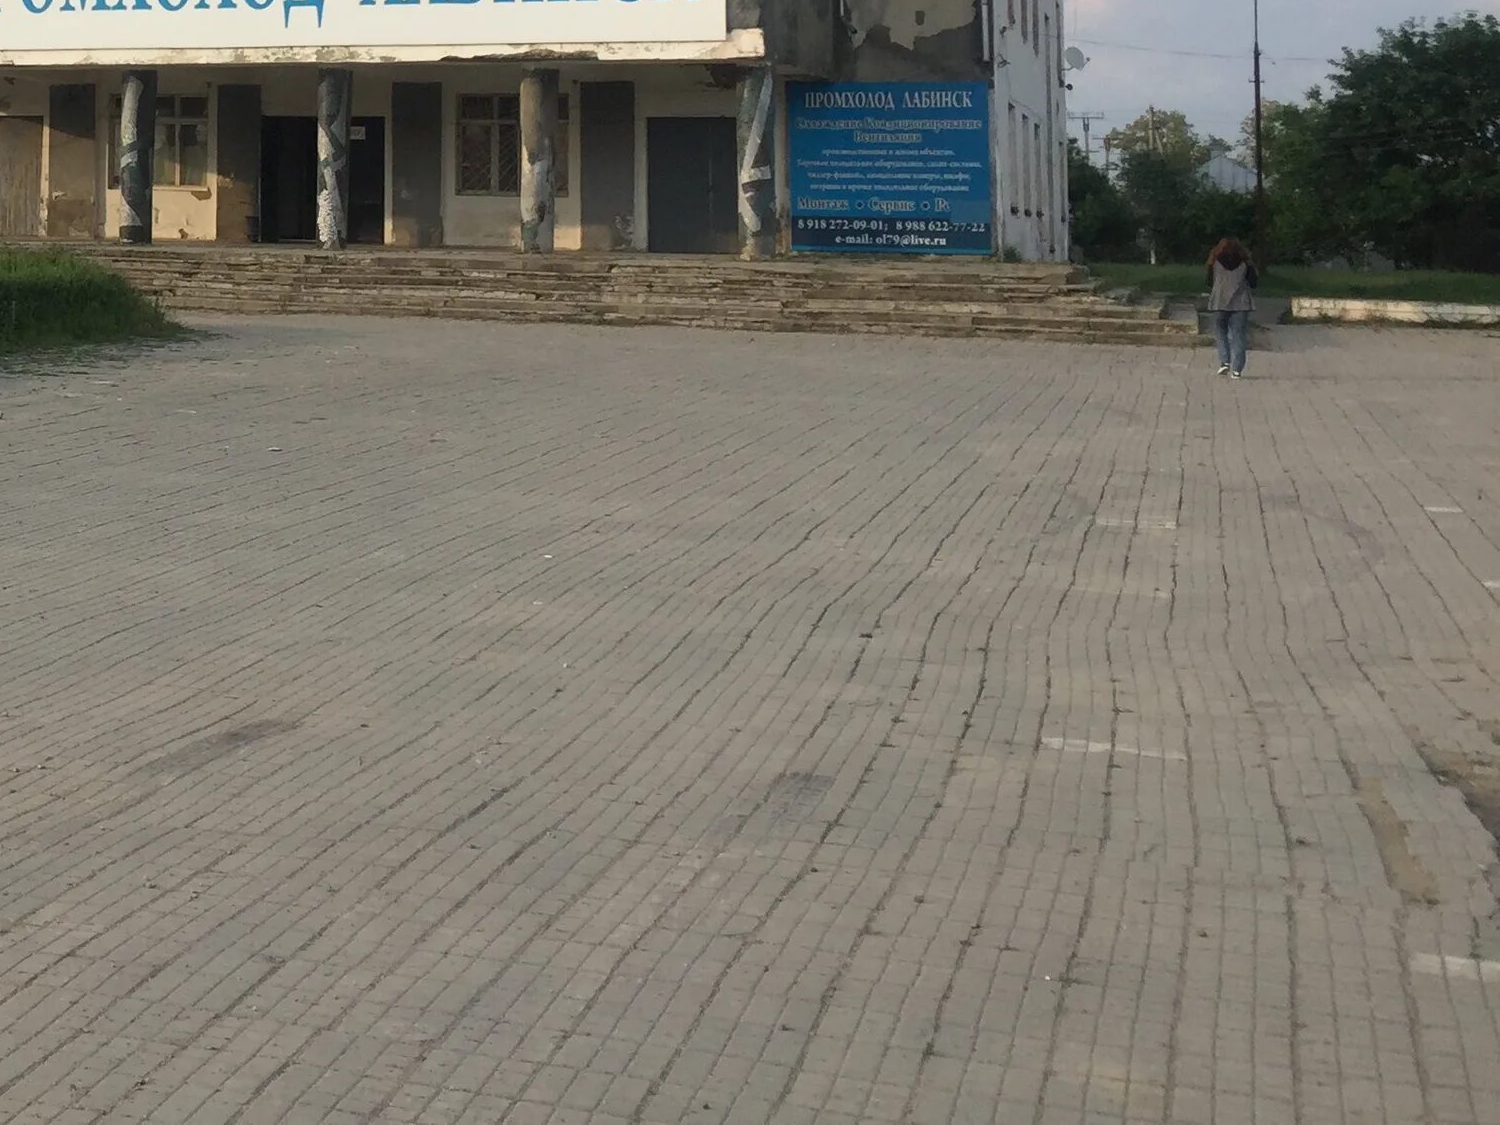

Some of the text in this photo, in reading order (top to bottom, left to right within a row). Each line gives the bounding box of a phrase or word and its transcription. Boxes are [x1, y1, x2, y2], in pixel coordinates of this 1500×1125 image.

[805, 90, 972, 111] ПРОМХОЛОД ЛАБИНСК
[797, 197, 849, 211] Монтаж
[868, 197, 916, 214] Сервис
[835, 234, 873, 245] e-mail:
